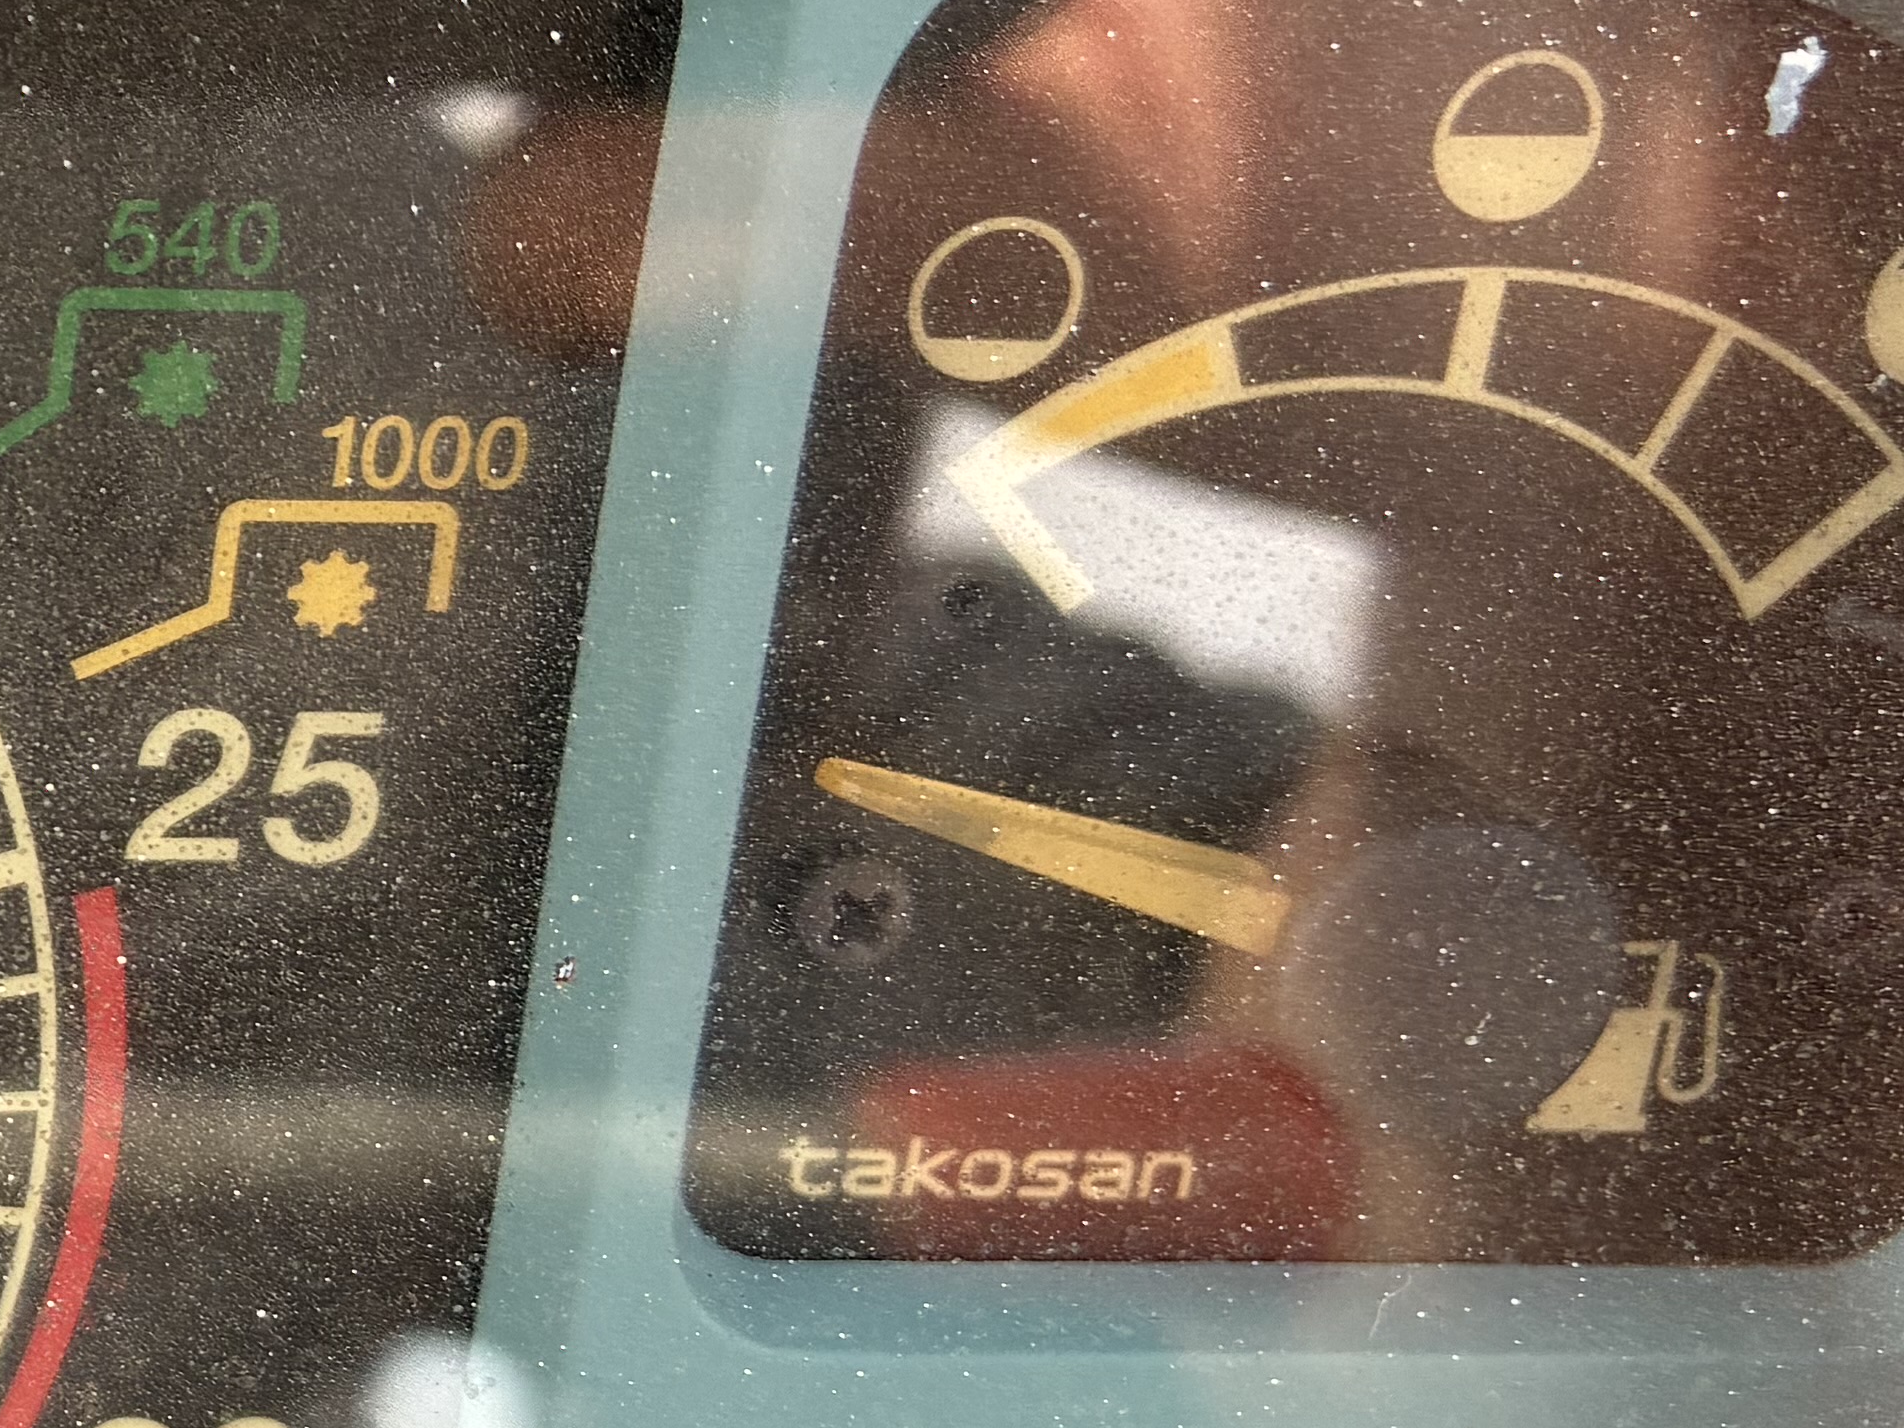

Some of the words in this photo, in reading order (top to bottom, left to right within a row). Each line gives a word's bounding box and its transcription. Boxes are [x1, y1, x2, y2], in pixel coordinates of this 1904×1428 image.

[103, 199, 282, 275] 540
[321, 415, 530, 490] 1000
[123, 707, 384, 867] 25
[777, 1134, 1194, 1199] takosan
